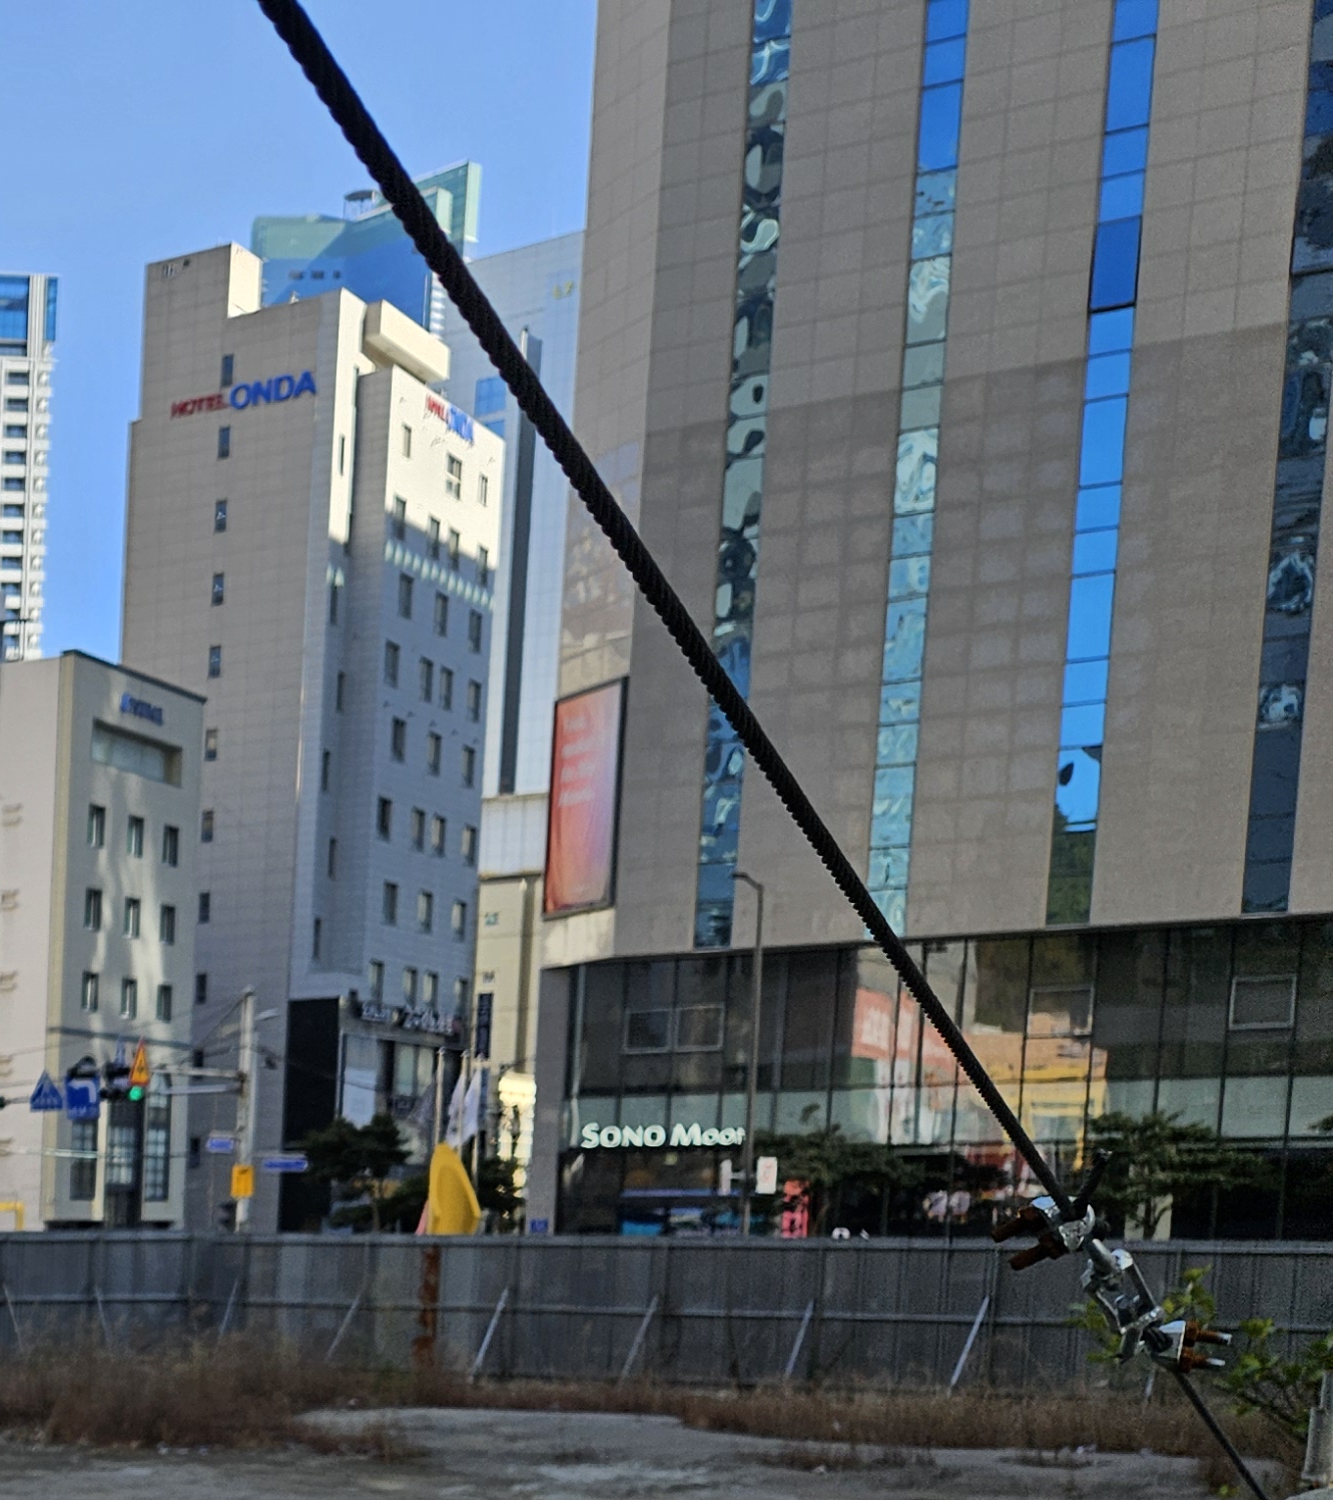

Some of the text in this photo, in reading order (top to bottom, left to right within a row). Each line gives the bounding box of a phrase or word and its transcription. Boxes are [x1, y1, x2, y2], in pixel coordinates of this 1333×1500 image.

[170, 369, 317, 420] HOTEL ONDA
[581, 1122, 666, 1149] SONO
